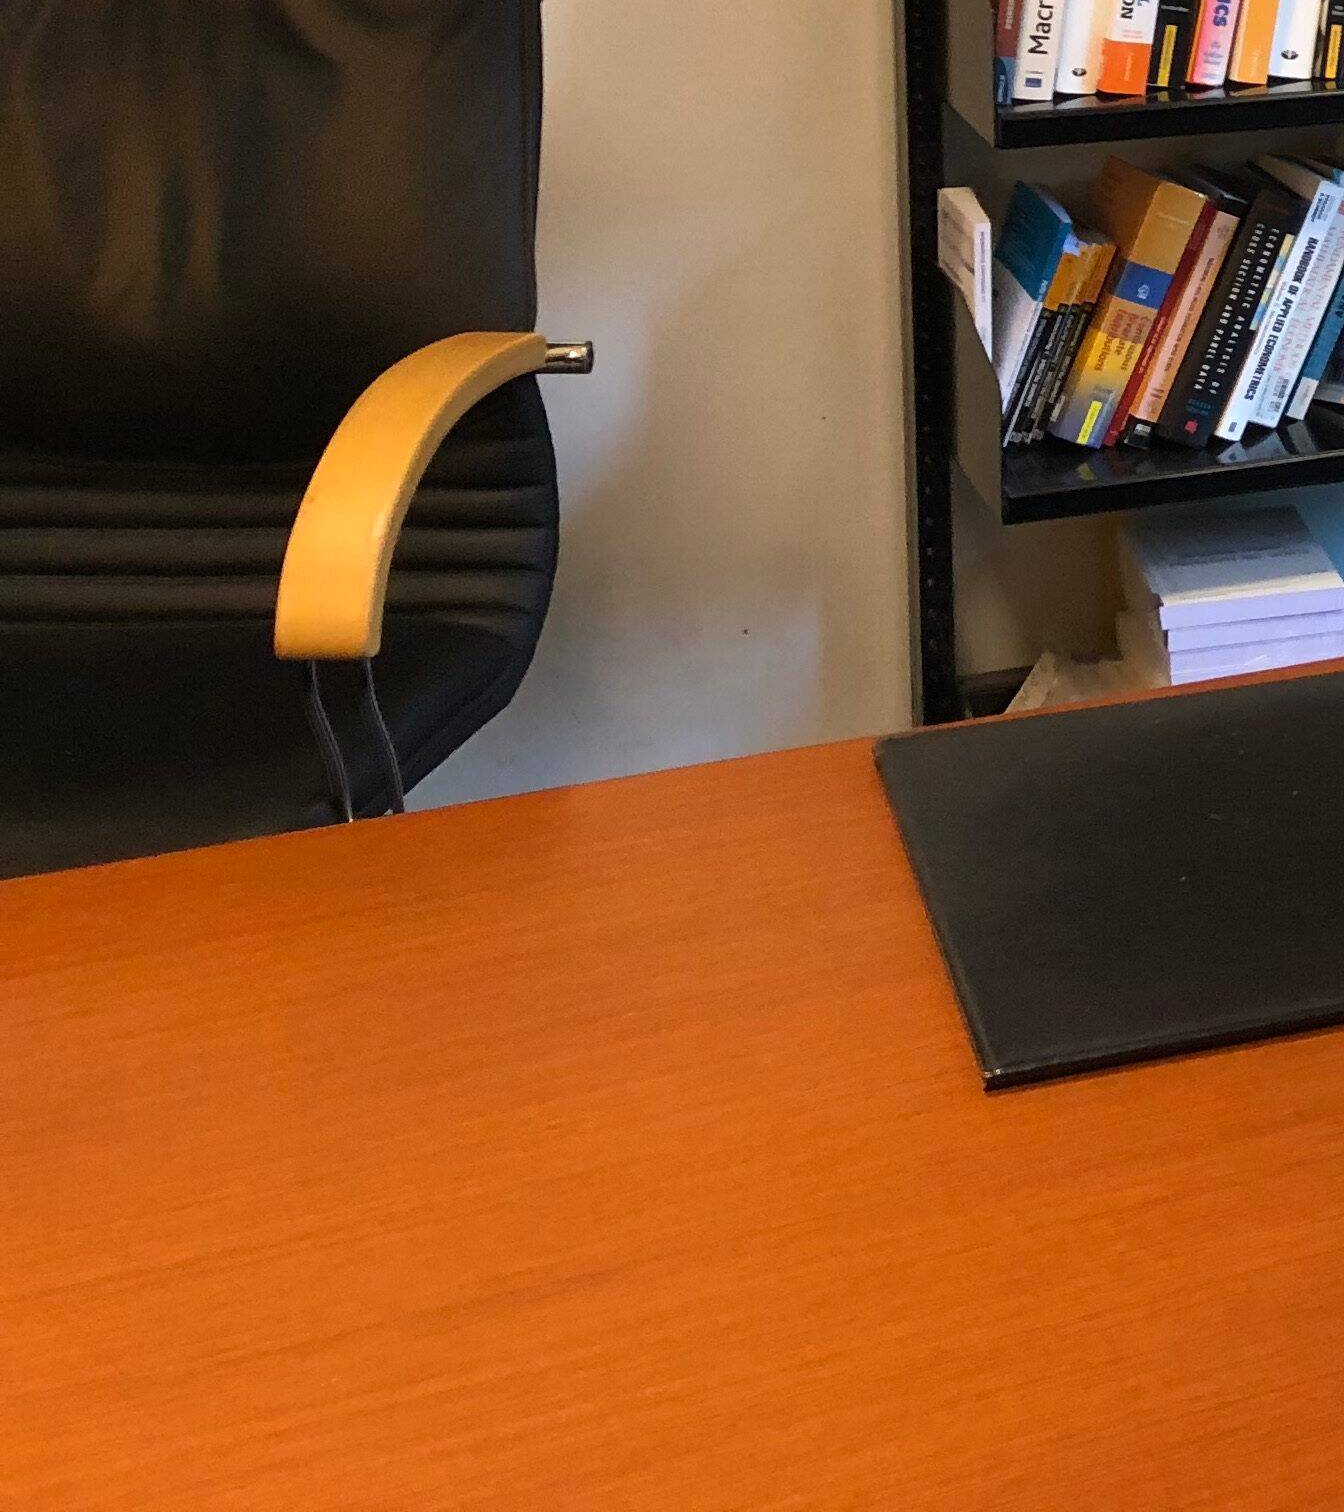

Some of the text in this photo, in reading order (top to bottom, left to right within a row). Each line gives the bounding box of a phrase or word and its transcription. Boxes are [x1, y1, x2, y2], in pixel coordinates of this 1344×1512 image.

[1241, 228, 1280, 309] ECONOMETRIC
[1287, 237, 1319, 283] HANDBOOK
[1193, 223, 1265, 390] CROSS SECTION AND PANEL DATA
[1271, 298, 1293, 332] APPLIED
[1288, 285, 1298, 297] OF
[1215, 316, 1246, 375] ANALYSIS
[1244, 334, 1279, 401] ECONOMETRICS
[1208, 381, 1221, 395] OF
